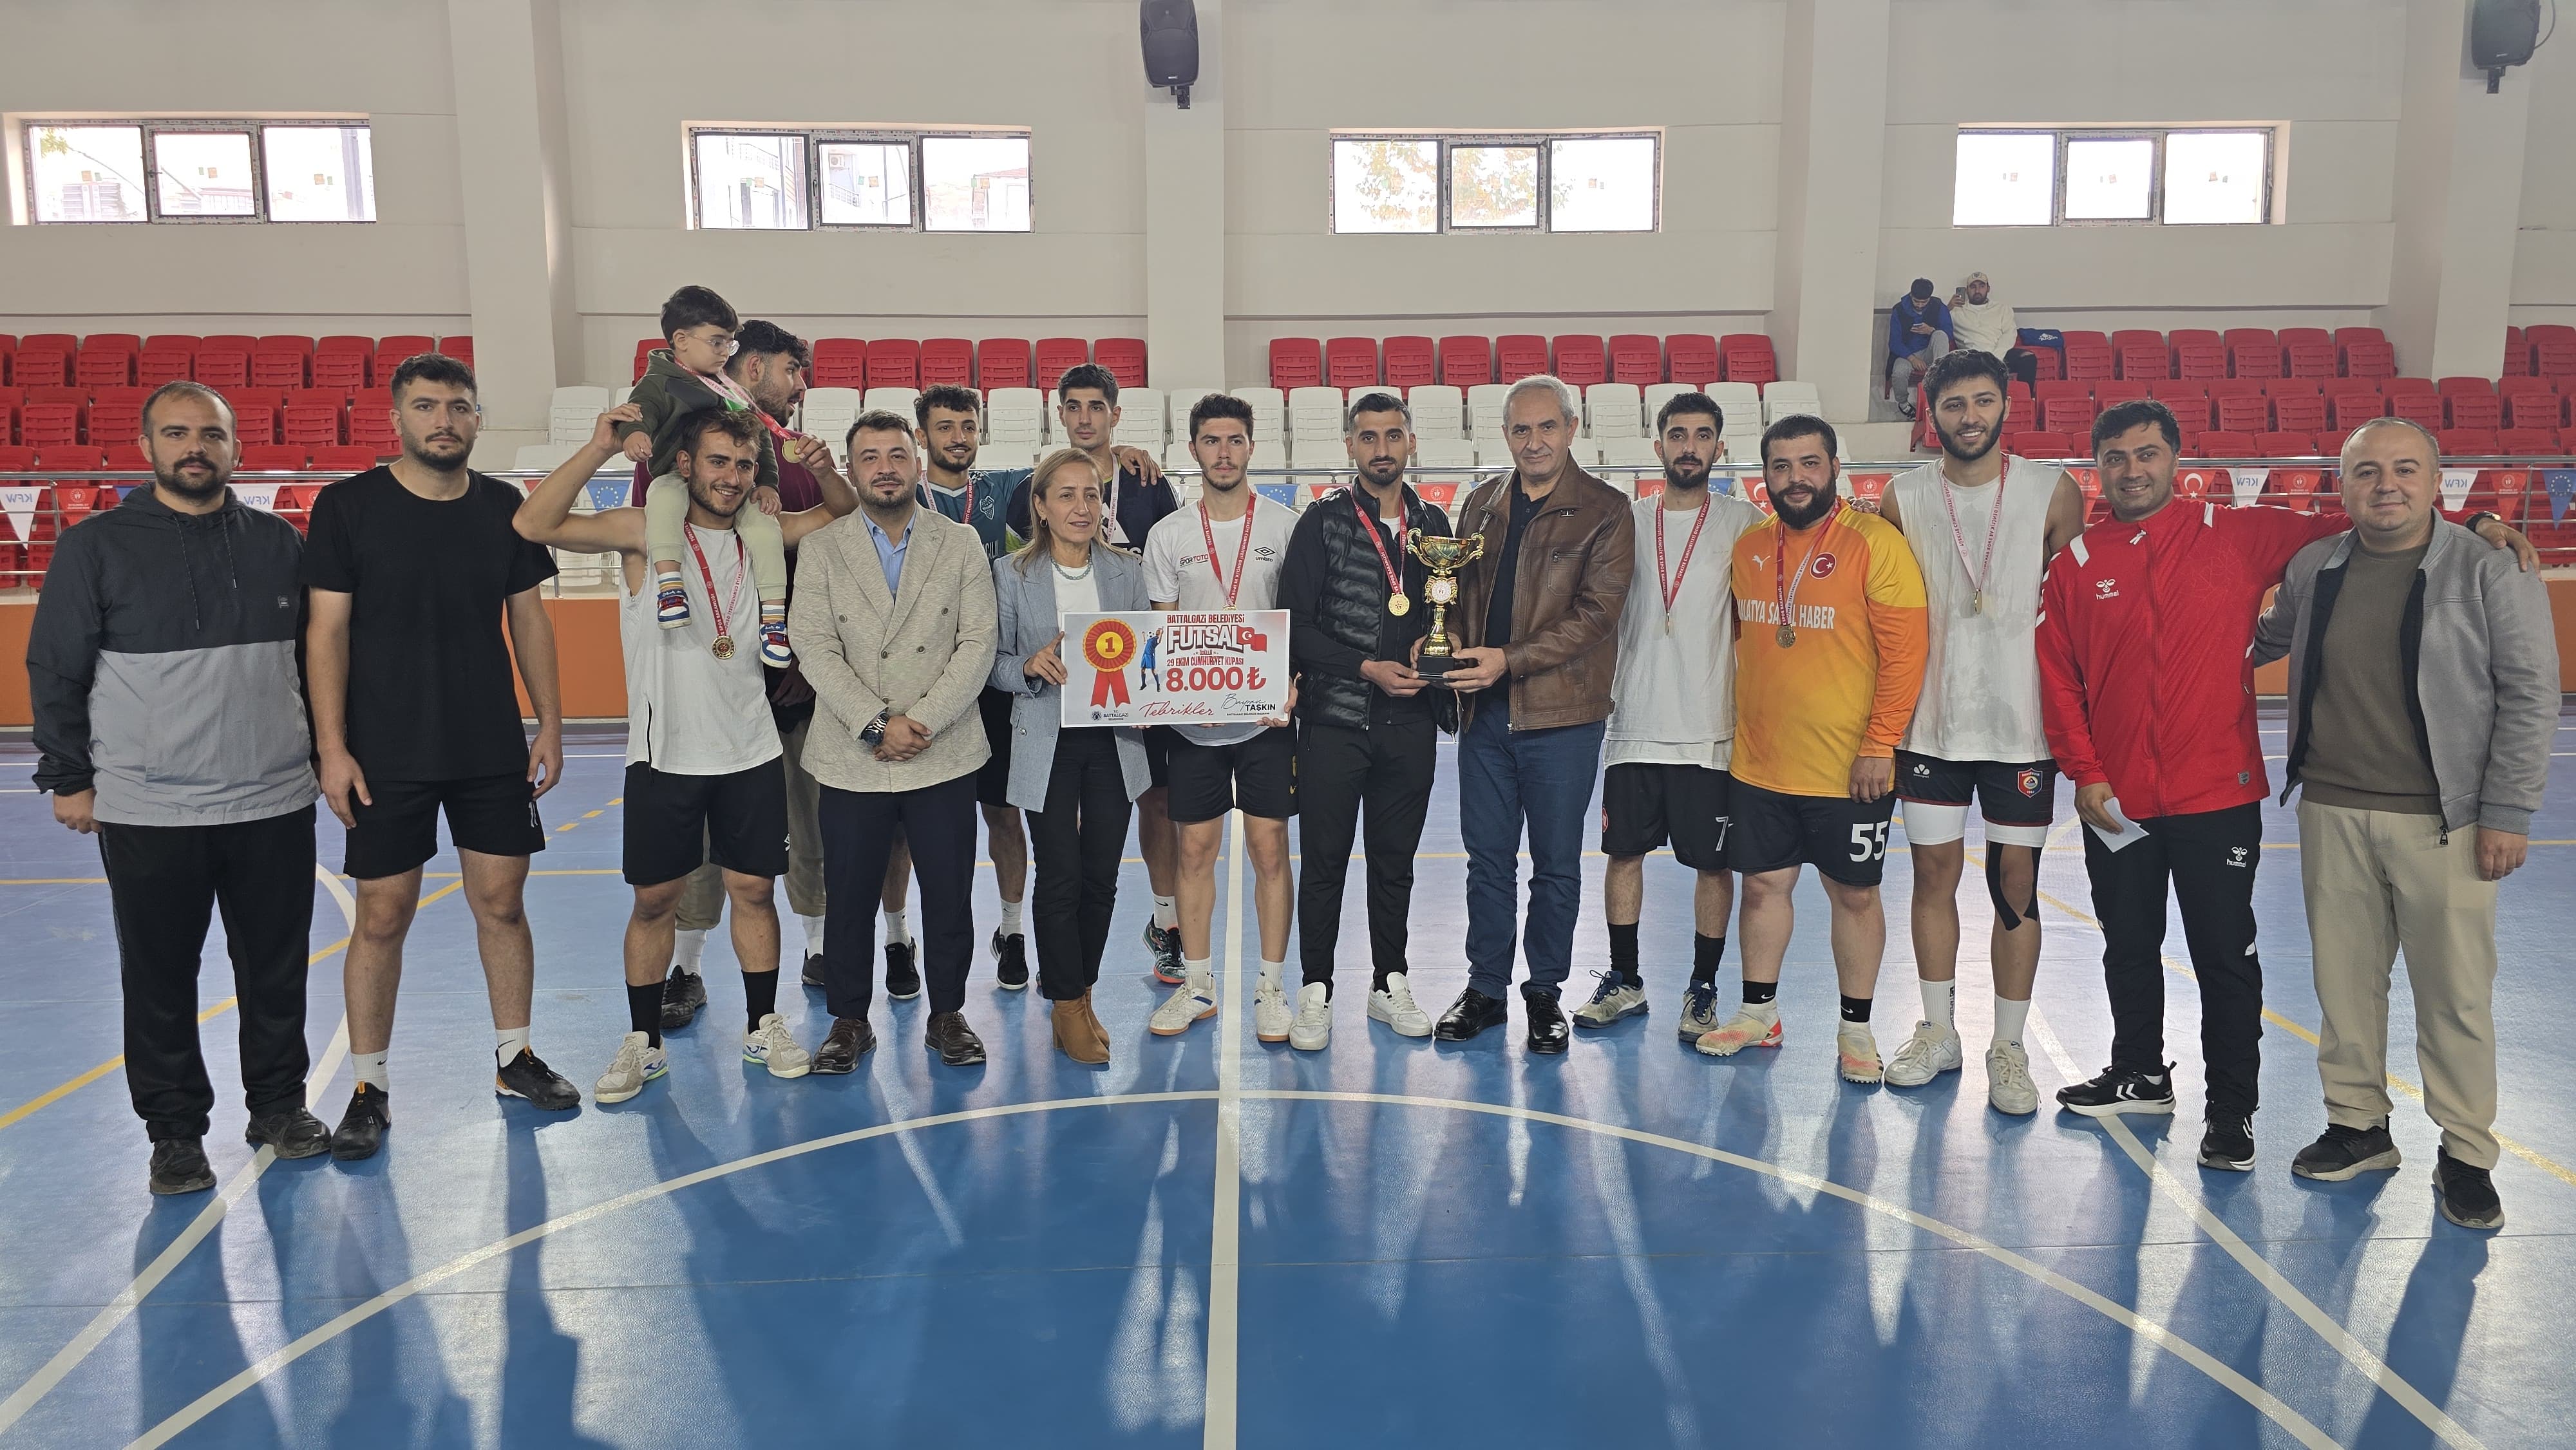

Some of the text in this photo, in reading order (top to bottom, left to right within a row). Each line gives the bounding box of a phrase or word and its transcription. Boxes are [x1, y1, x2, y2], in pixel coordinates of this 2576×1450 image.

[1388, 574, 1397, 585] SPOR
[2096, 590, 2119, 599] hummel
[1799, 605, 1835, 629] HABER
[1105, 636, 1115, 653] 1
[1167, 625, 1244, 655] FUTSAL
[1225, 657, 1244, 665] KUPASI
[1139, 701, 1214, 717] Tebrikler
[1715, 816, 1729, 851] 7
[1849, 820, 1888, 862] 55
